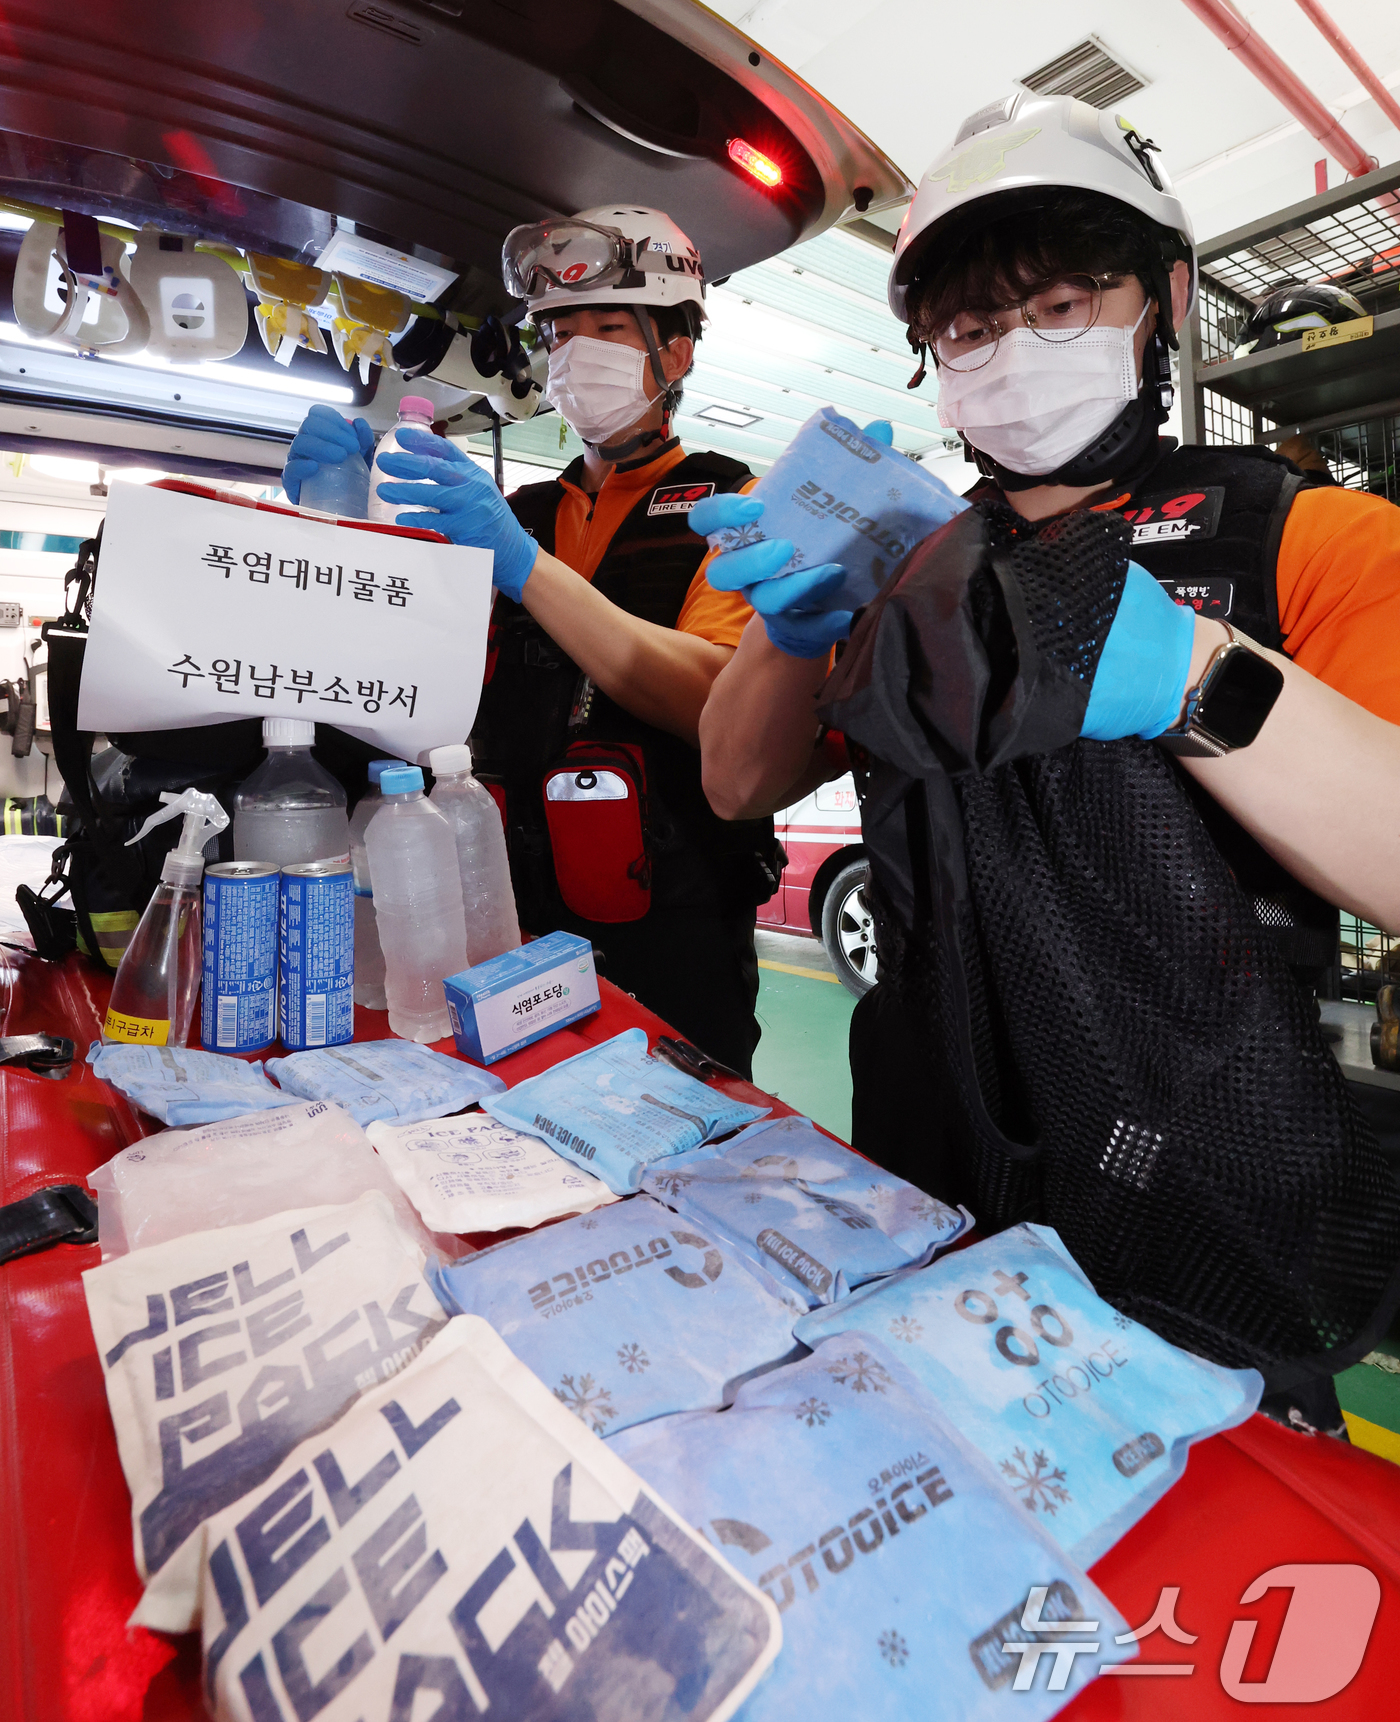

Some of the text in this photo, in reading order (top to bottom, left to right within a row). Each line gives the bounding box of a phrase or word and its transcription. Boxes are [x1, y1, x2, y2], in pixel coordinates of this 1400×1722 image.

[652, 503, 678, 512] FIRE
[659, 486, 708, 503] 119
[200, 543, 413, 607] 폭염대비물품
[166, 653, 418, 718] 수원남부소방서
[511, 983, 563, 1016] 식염포도당
[428, 1129, 462, 1138] ICE
[466, 1122, 504, 1133] PAC
[532, 1113, 557, 1138] PACK
[556, 1127, 573, 1146] ICE
[571, 1136, 597, 1161] OTOO
[528, 1238, 673, 1311] OTOOICE
[777, 1243, 799, 1265] ICE
[793, 1255, 827, 1287] PACK
[105, 1228, 351, 1369] JELL
[152, 1290, 313, 1402] ICE
[1023, 1339, 1128, 1418] OTOOICE
[142, 1283, 432, 1540] PACK
[207, 1397, 462, 1712] JELL
[240, 1492, 449, 1722] ICE
[537, 1526, 651, 1694] 젤 아이스팩
